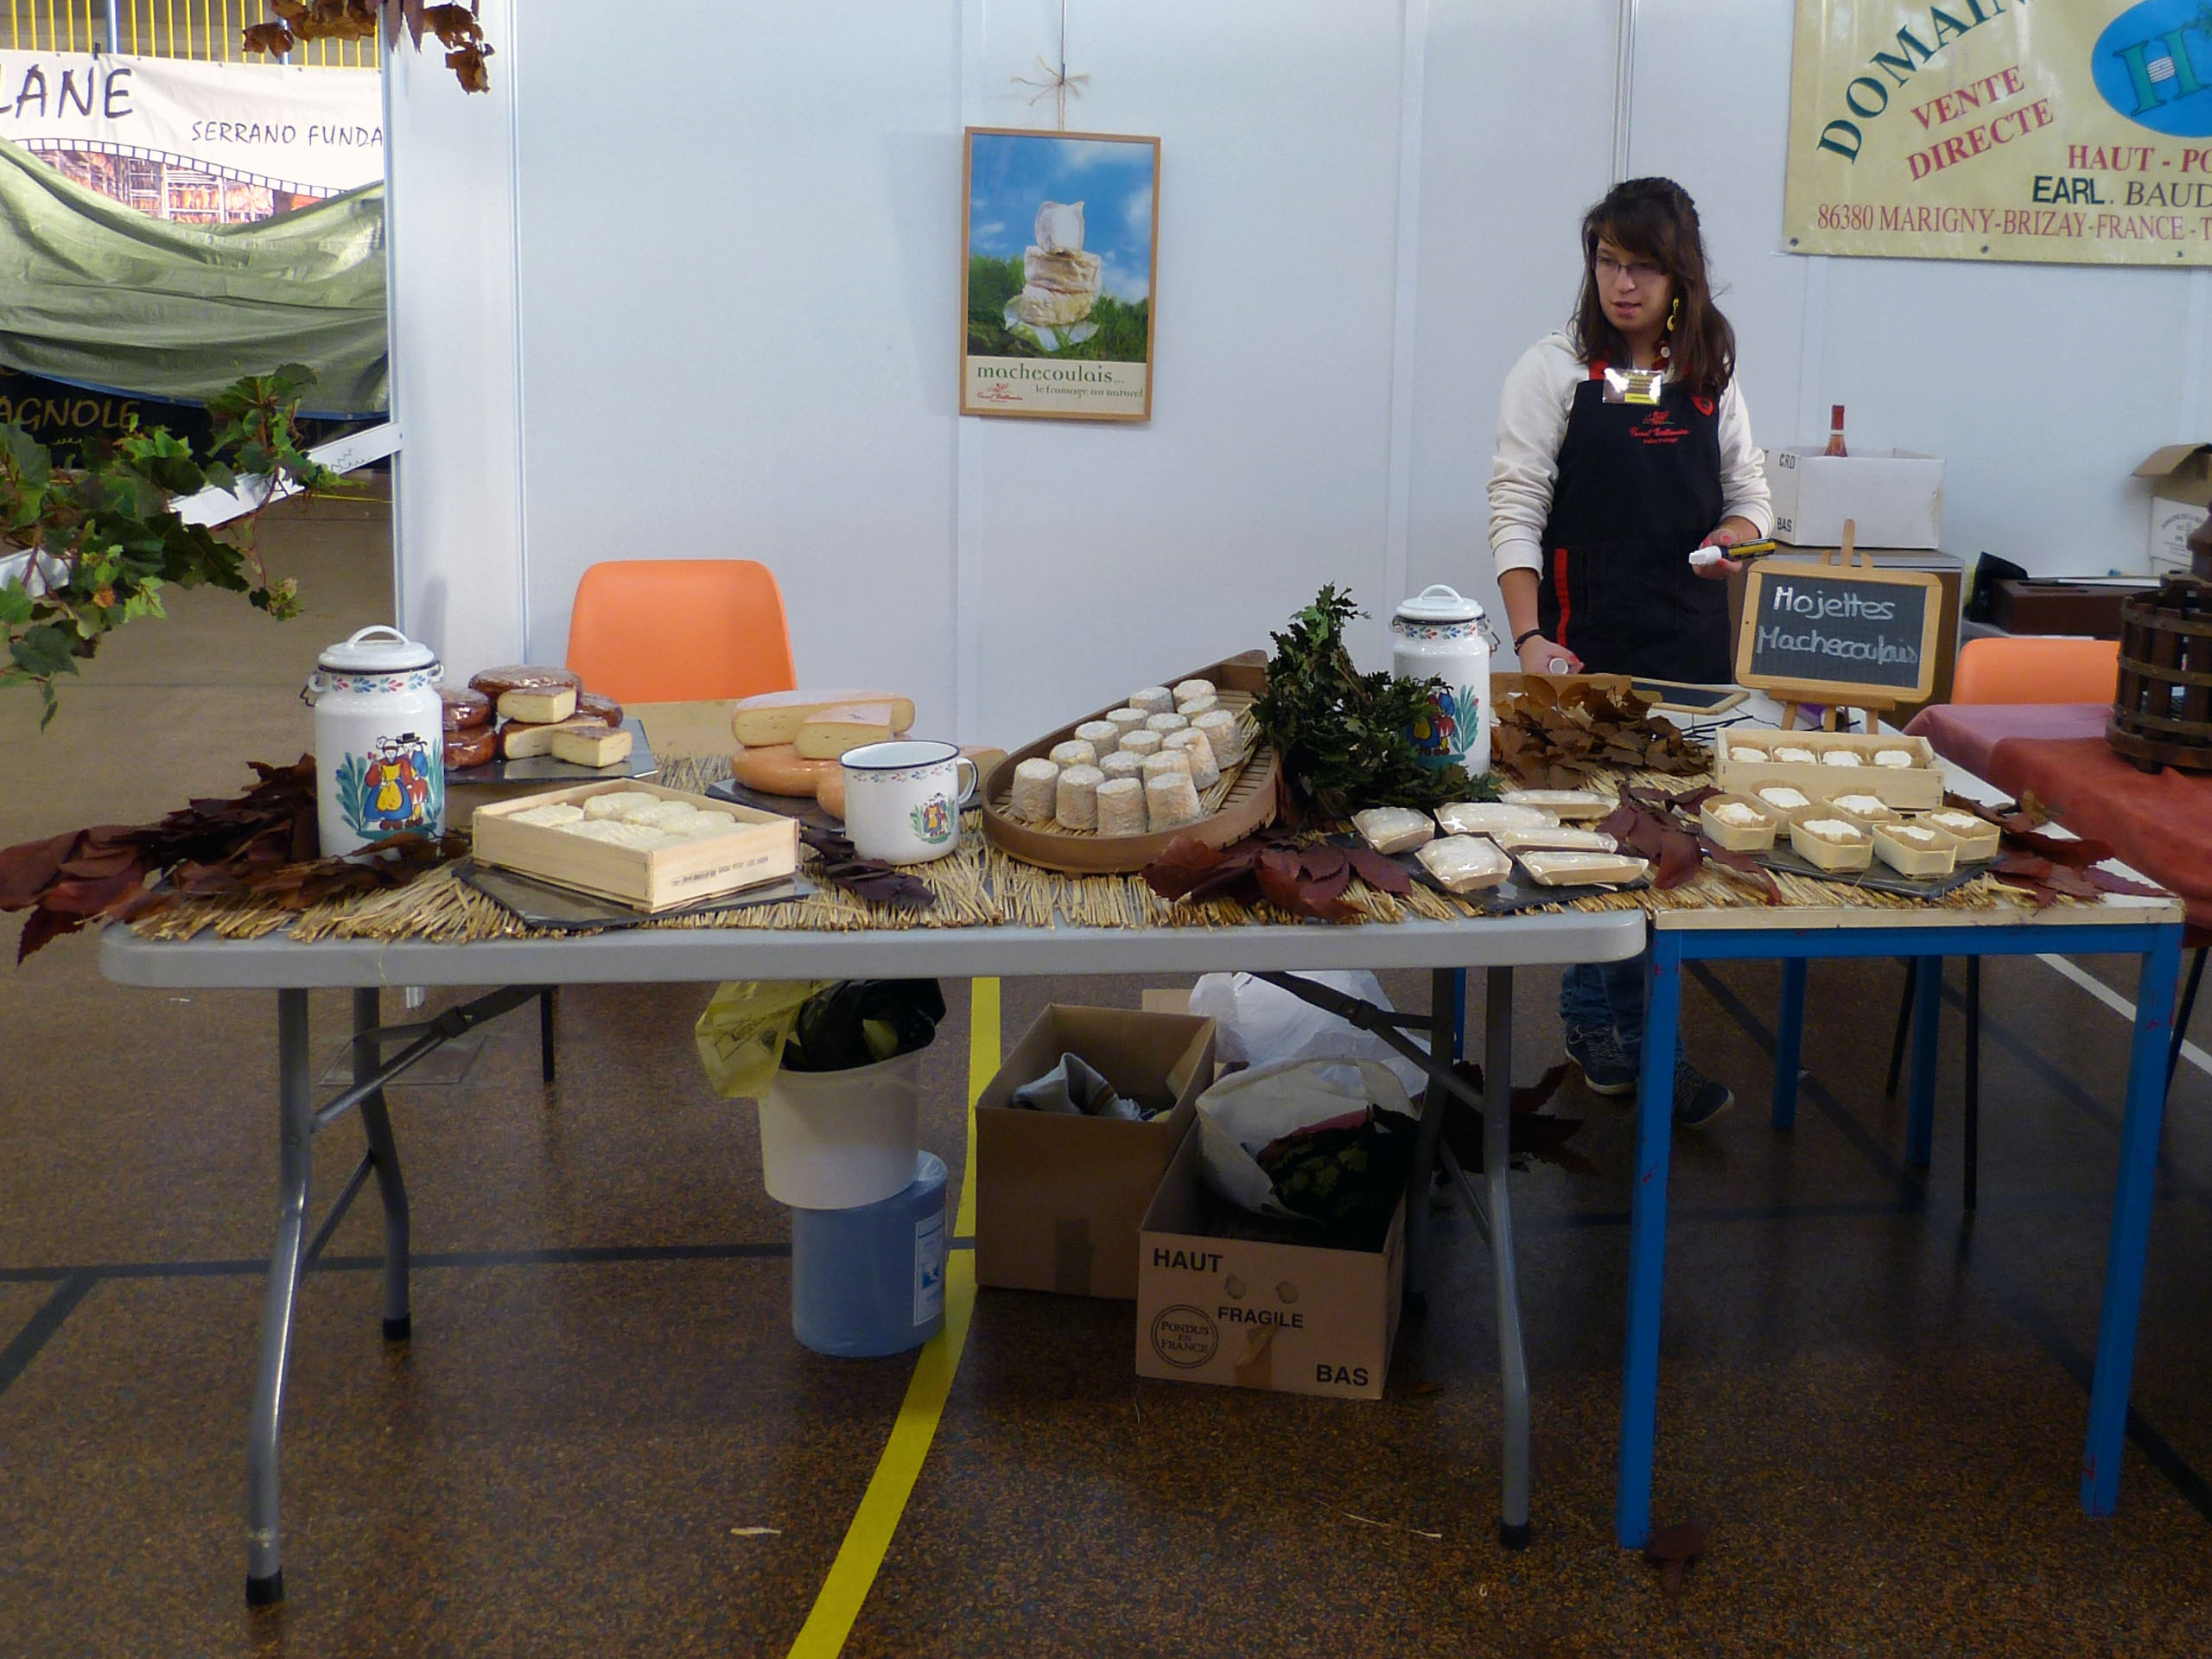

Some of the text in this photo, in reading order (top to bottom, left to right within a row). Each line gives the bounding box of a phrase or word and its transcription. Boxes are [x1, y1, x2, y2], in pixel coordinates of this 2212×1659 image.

[1909, 65, 2025, 131] VENTE
[192, 120, 383, 147] SERRANO FUNDA
[1904, 98, 2055, 182] DIRECTE
[2068, 144, 2155, 171] HAUT
[2123, 181, 2212, 208] BAUD
[1817, 203, 1874, 231] 86380
[1035, 385, 1045, 394] le
[1777, 517, 1793, 533] BAS
[1154, 1247, 1224, 1273] HAUT
[1217, 1306, 1304, 1329] FRAGILE
[1316, 1363, 1370, 1388] BAS
